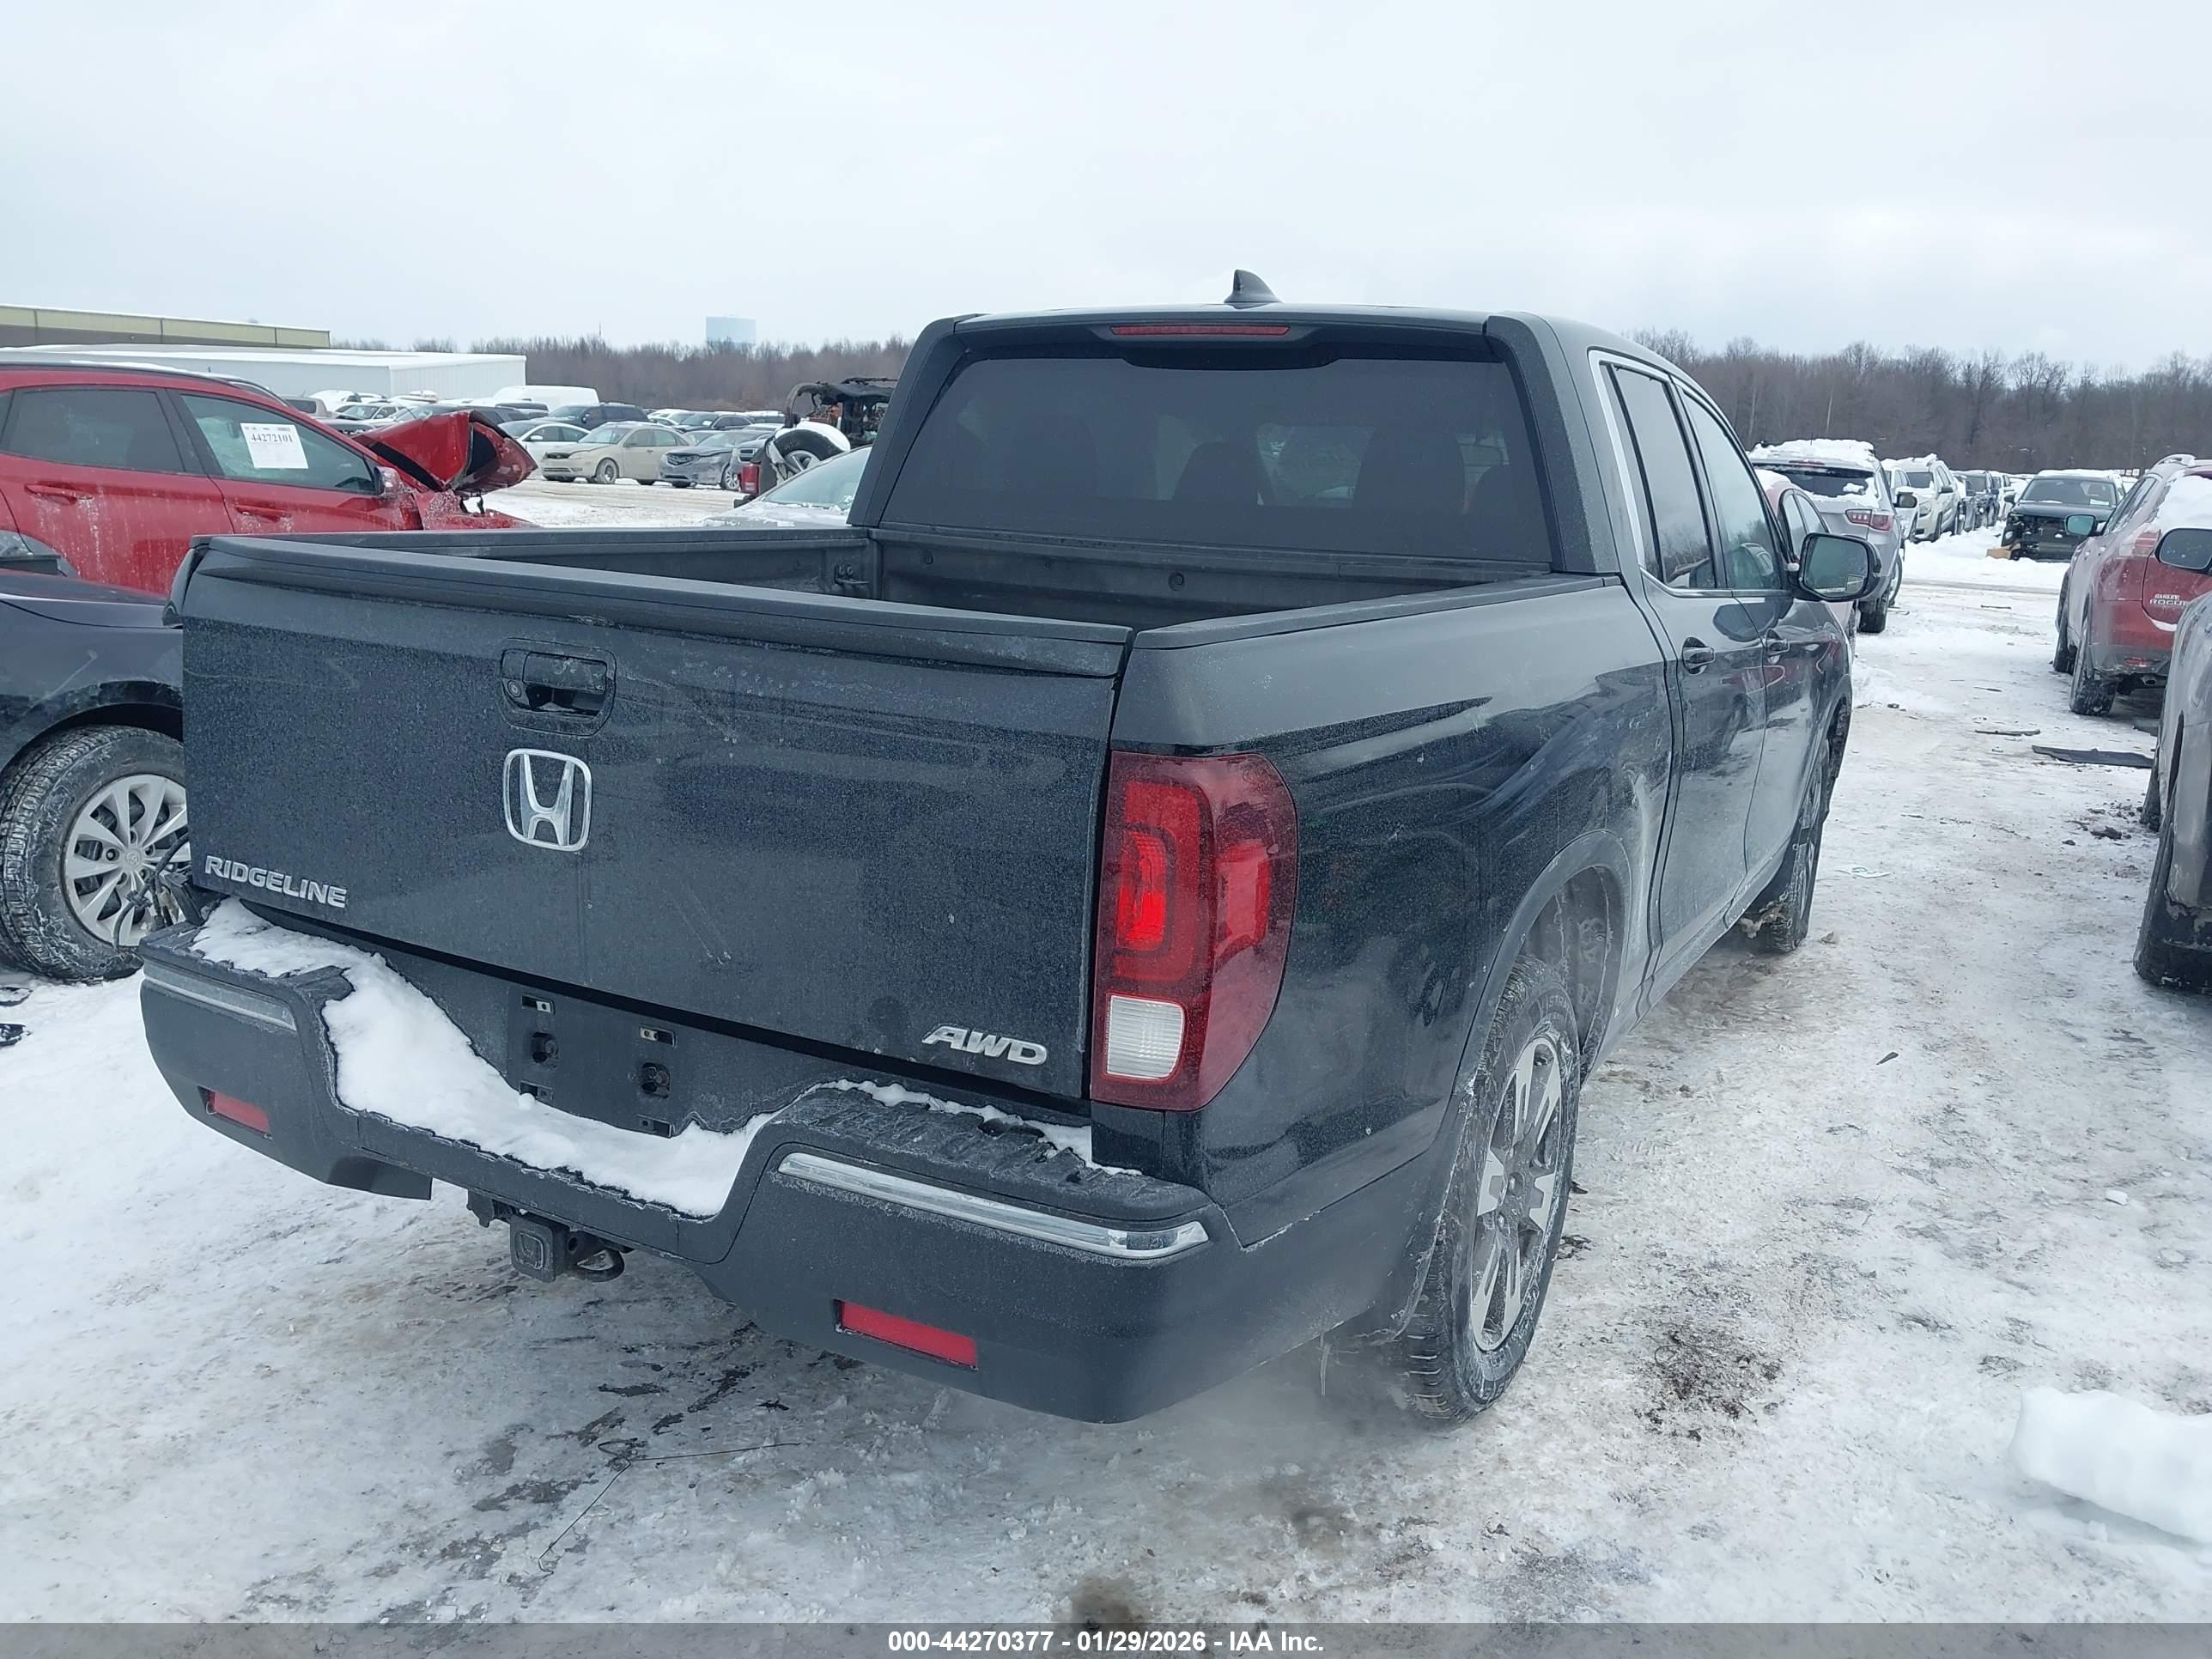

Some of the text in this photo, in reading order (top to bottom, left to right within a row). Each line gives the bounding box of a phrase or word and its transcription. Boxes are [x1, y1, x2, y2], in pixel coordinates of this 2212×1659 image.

[251, 433, 293, 442] 44272101
[204, 855, 347, 908] RIDGELINE
[921, 1025, 1048, 1066] AWD
